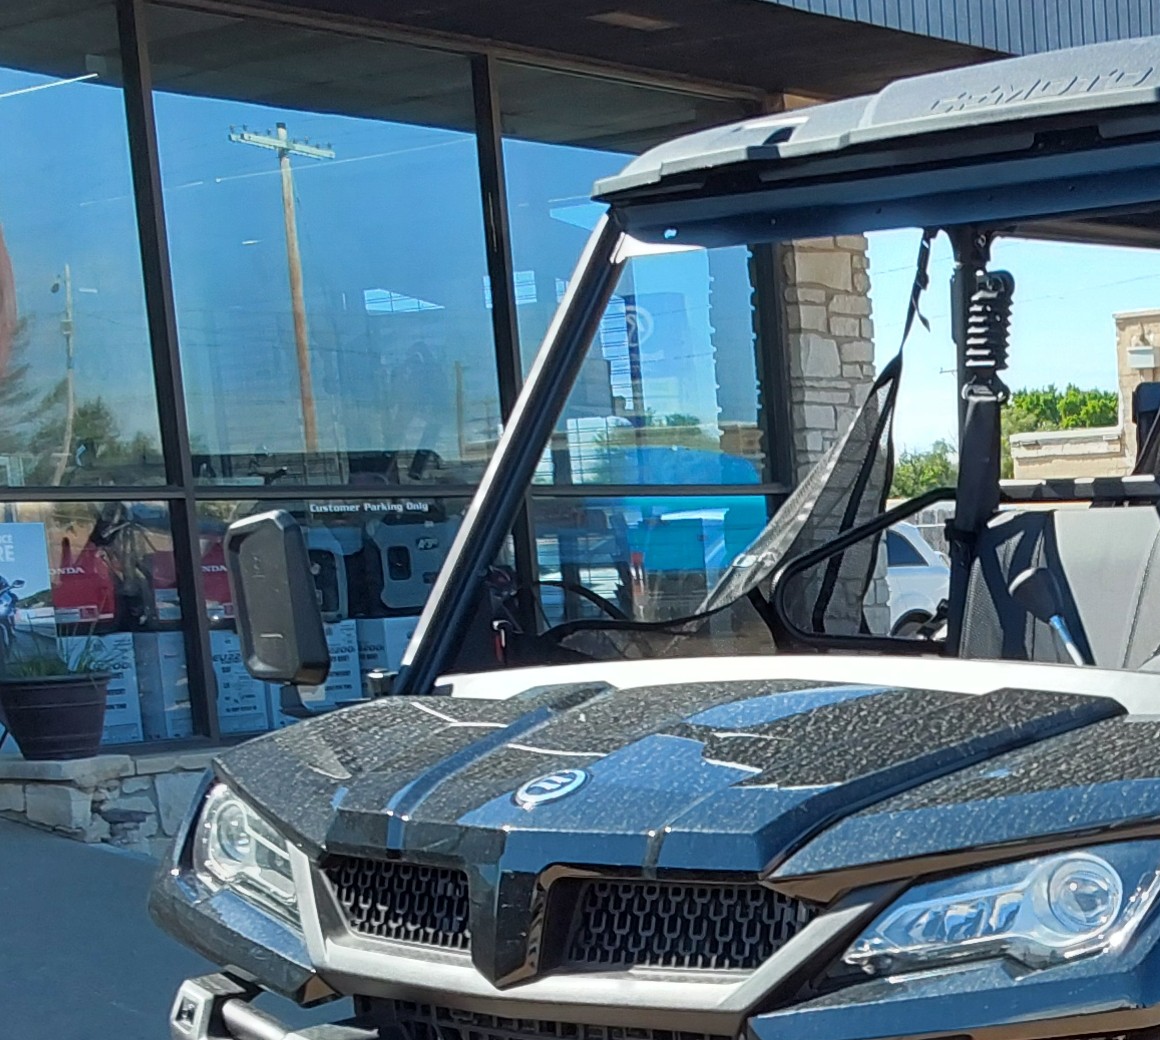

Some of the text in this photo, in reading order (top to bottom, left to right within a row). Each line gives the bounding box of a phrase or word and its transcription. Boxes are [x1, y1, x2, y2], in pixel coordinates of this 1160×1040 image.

[309, 501, 429, 513] Customer Parking Only
